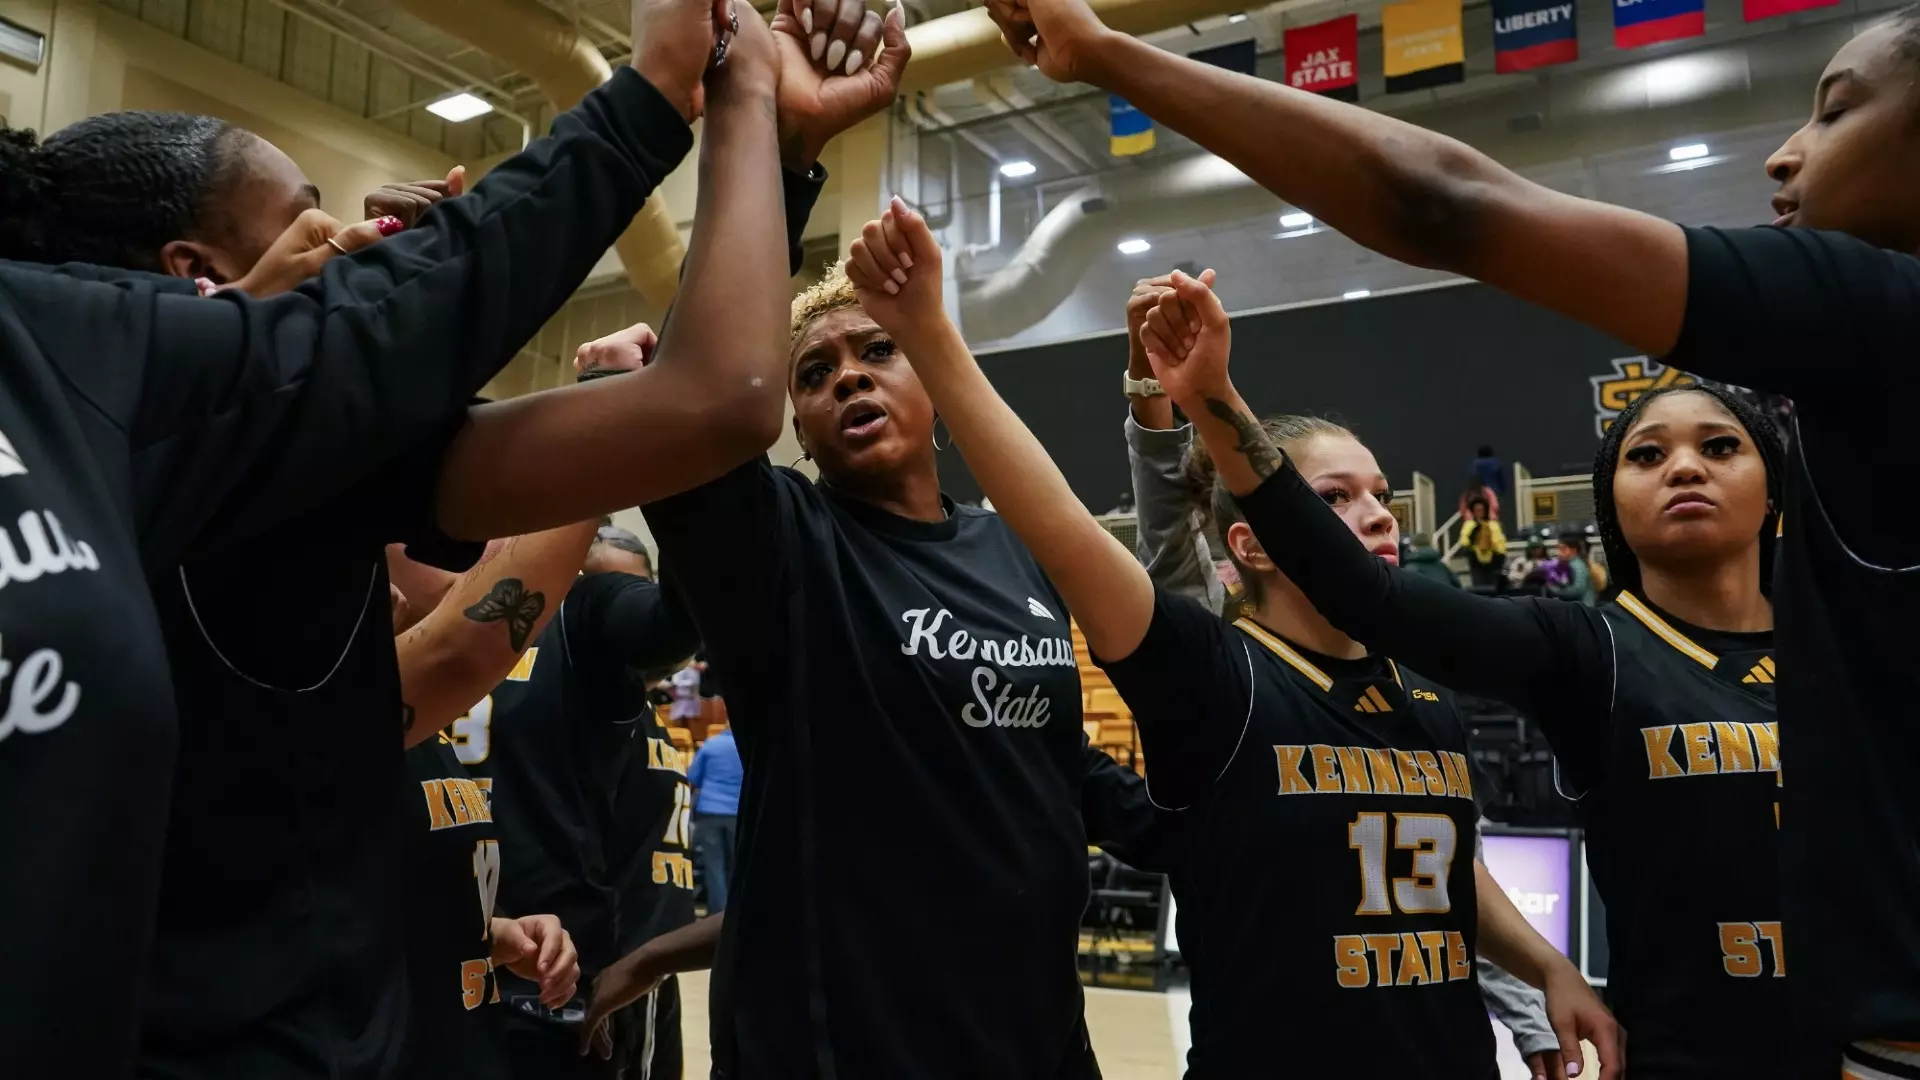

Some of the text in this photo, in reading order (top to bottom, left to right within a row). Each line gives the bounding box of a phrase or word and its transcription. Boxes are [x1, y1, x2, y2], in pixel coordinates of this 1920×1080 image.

[1495, 4, 1573, 33] LIBERTY
[1291, 61, 1352, 87] STATE
[1301, 47, 1340, 68] JAX
[961, 666, 1051, 728] State
[1348, 811, 1458, 915] 13
[1333, 931, 1471, 988] STATE
